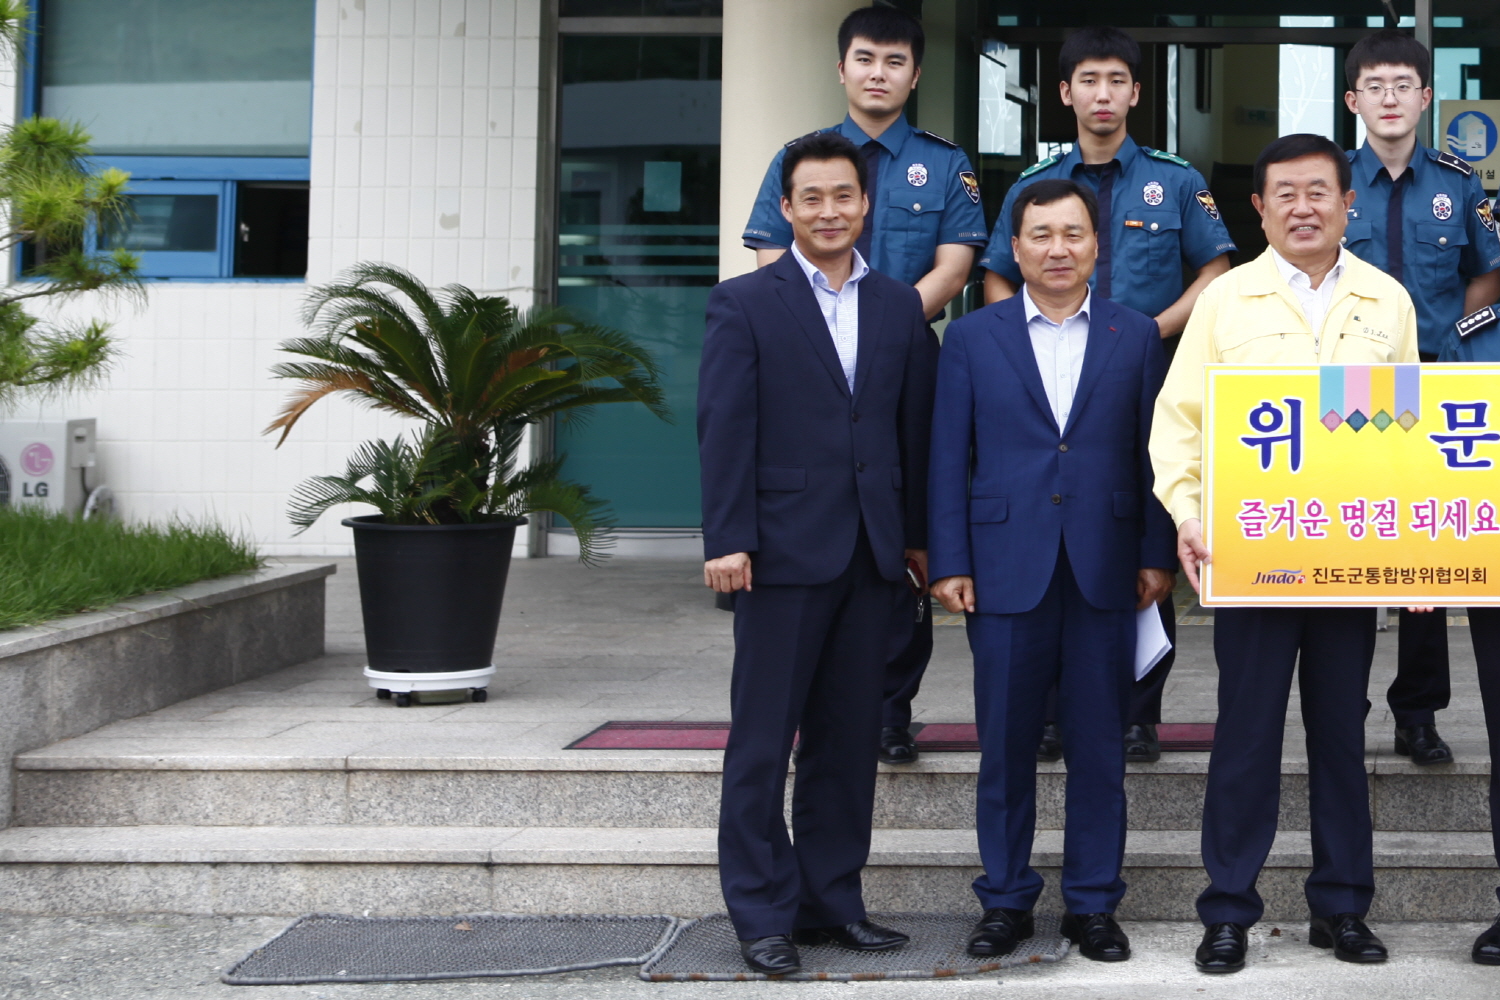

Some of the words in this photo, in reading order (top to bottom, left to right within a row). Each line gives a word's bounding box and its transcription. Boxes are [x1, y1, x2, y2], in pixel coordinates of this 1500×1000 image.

[1240, 398, 1303, 472] 위
[22, 482, 49, 498] LG
[1238, 499, 1329, 538] 즐거운
[1341, 499, 1398, 539] 명절
[1411, 499, 1500, 538] 되세요
[1251, 571, 1296, 585] Jindo
[1312, 566, 1488, 585] 진도군통합방위협의회
